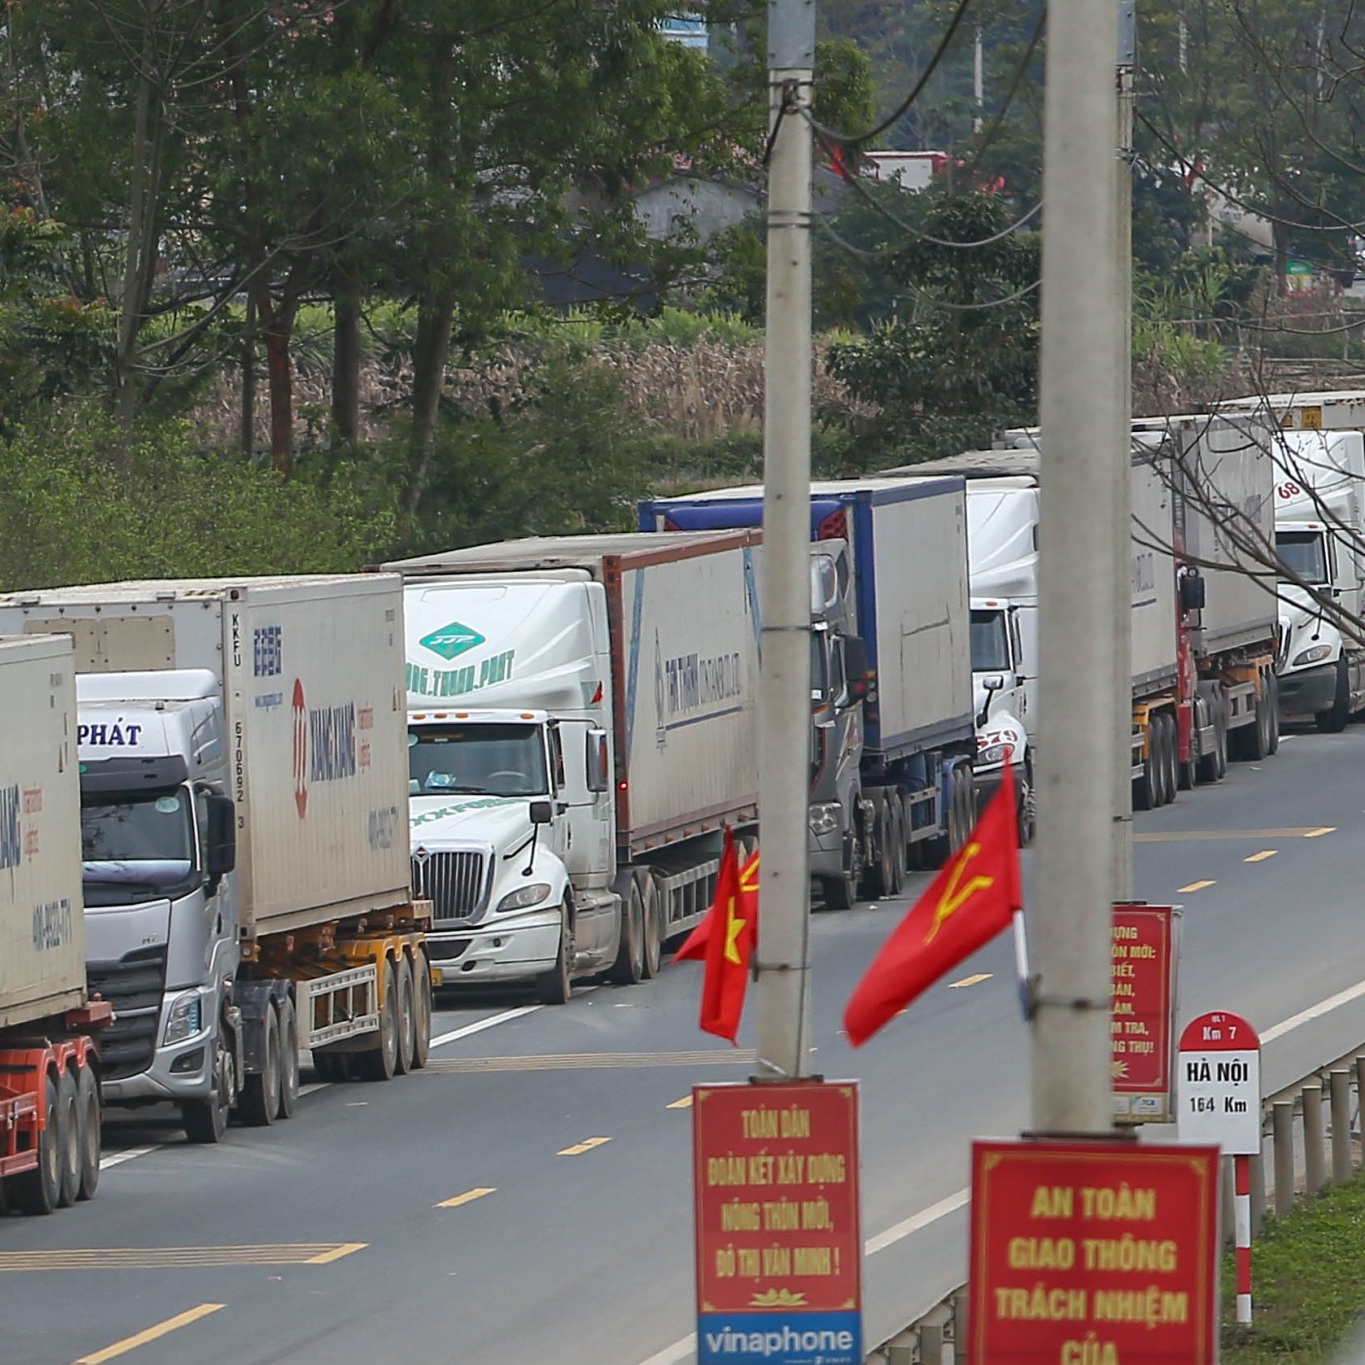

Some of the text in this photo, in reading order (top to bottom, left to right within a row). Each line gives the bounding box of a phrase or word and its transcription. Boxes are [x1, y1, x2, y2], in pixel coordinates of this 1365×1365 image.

[1278, 482, 1300, 500] 68
[232, 614, 242, 667] KKFU
[77, 717, 142, 746] PHÁT
[235, 722, 244, 802] 670692
[1111, 926, 1138, 941] ỰNG
[1203, 1026, 1237, 1040] Km 7
[1186, 1057, 1248, 1086] HÀ NỘI
[742, 1103, 811, 1139] TOÀN DÂN
[1190, 1096, 1247, 1113] 164 Km
[748, 1148, 775, 1185] KẾT
[777, 1150, 805, 1184] XÂY
[1030, 1181, 1157, 1220] AN TOÀN
[1008, 1232, 1178, 1272] GIAO THÔNG
[995, 1281, 1188, 1330] TRÁCH NHIỆM
[706, 1325, 854, 1356] vinaphone
